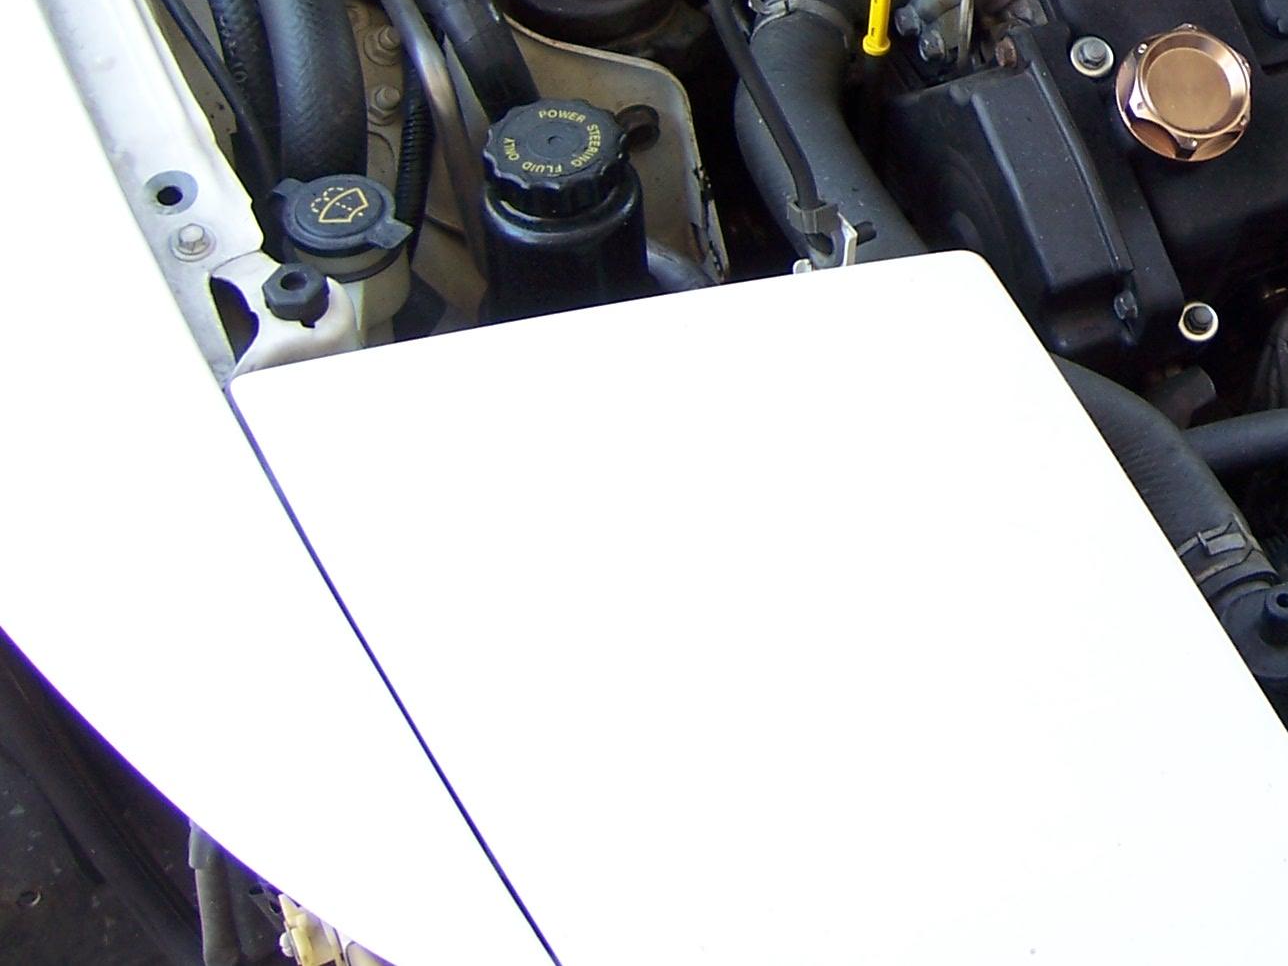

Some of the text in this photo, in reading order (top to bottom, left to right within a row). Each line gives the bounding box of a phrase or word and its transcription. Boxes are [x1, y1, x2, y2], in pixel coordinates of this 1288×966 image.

[503, 109, 602, 174] POWER STEERING FLUID ONLY
